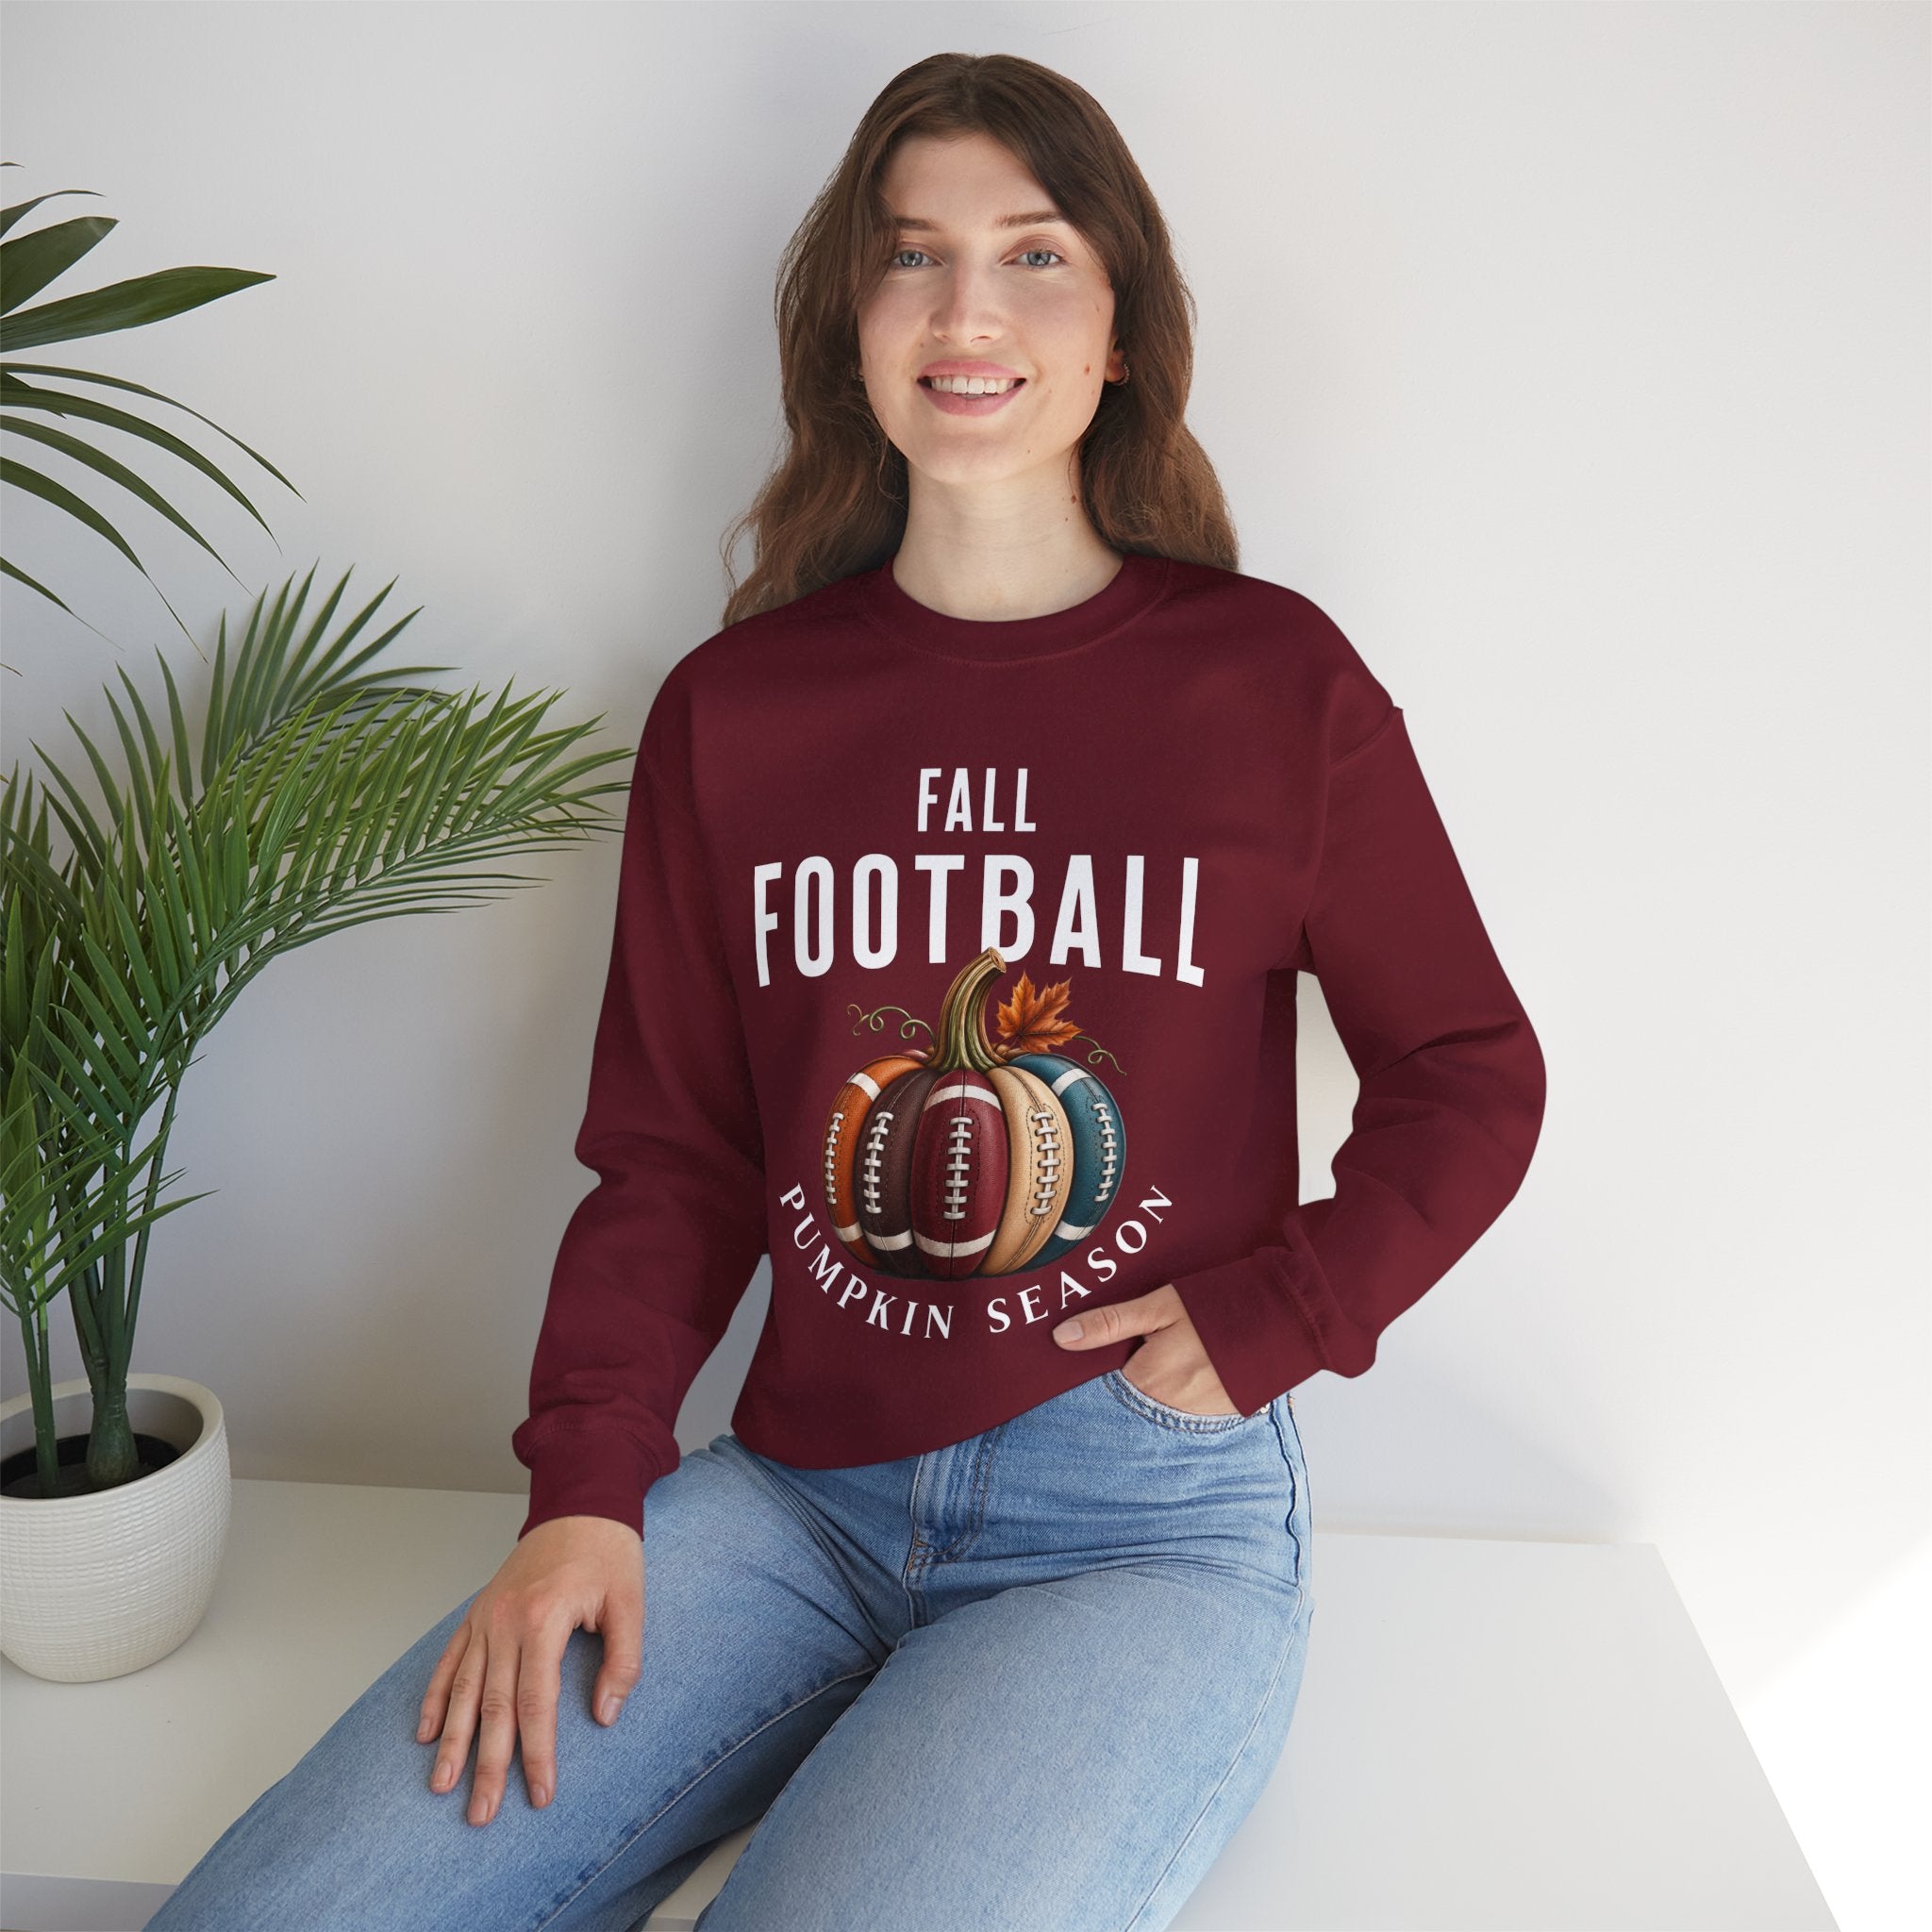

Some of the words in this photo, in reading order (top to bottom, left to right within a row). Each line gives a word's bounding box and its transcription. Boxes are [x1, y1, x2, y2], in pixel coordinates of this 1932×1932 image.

[917, 767, 1037, 832] FALL
[754, 853, 1205, 988] FOOTBALL
[779, 1182, 954, 1339] PUMPKIN
[986, 1184, 1174, 1334] SEASON
